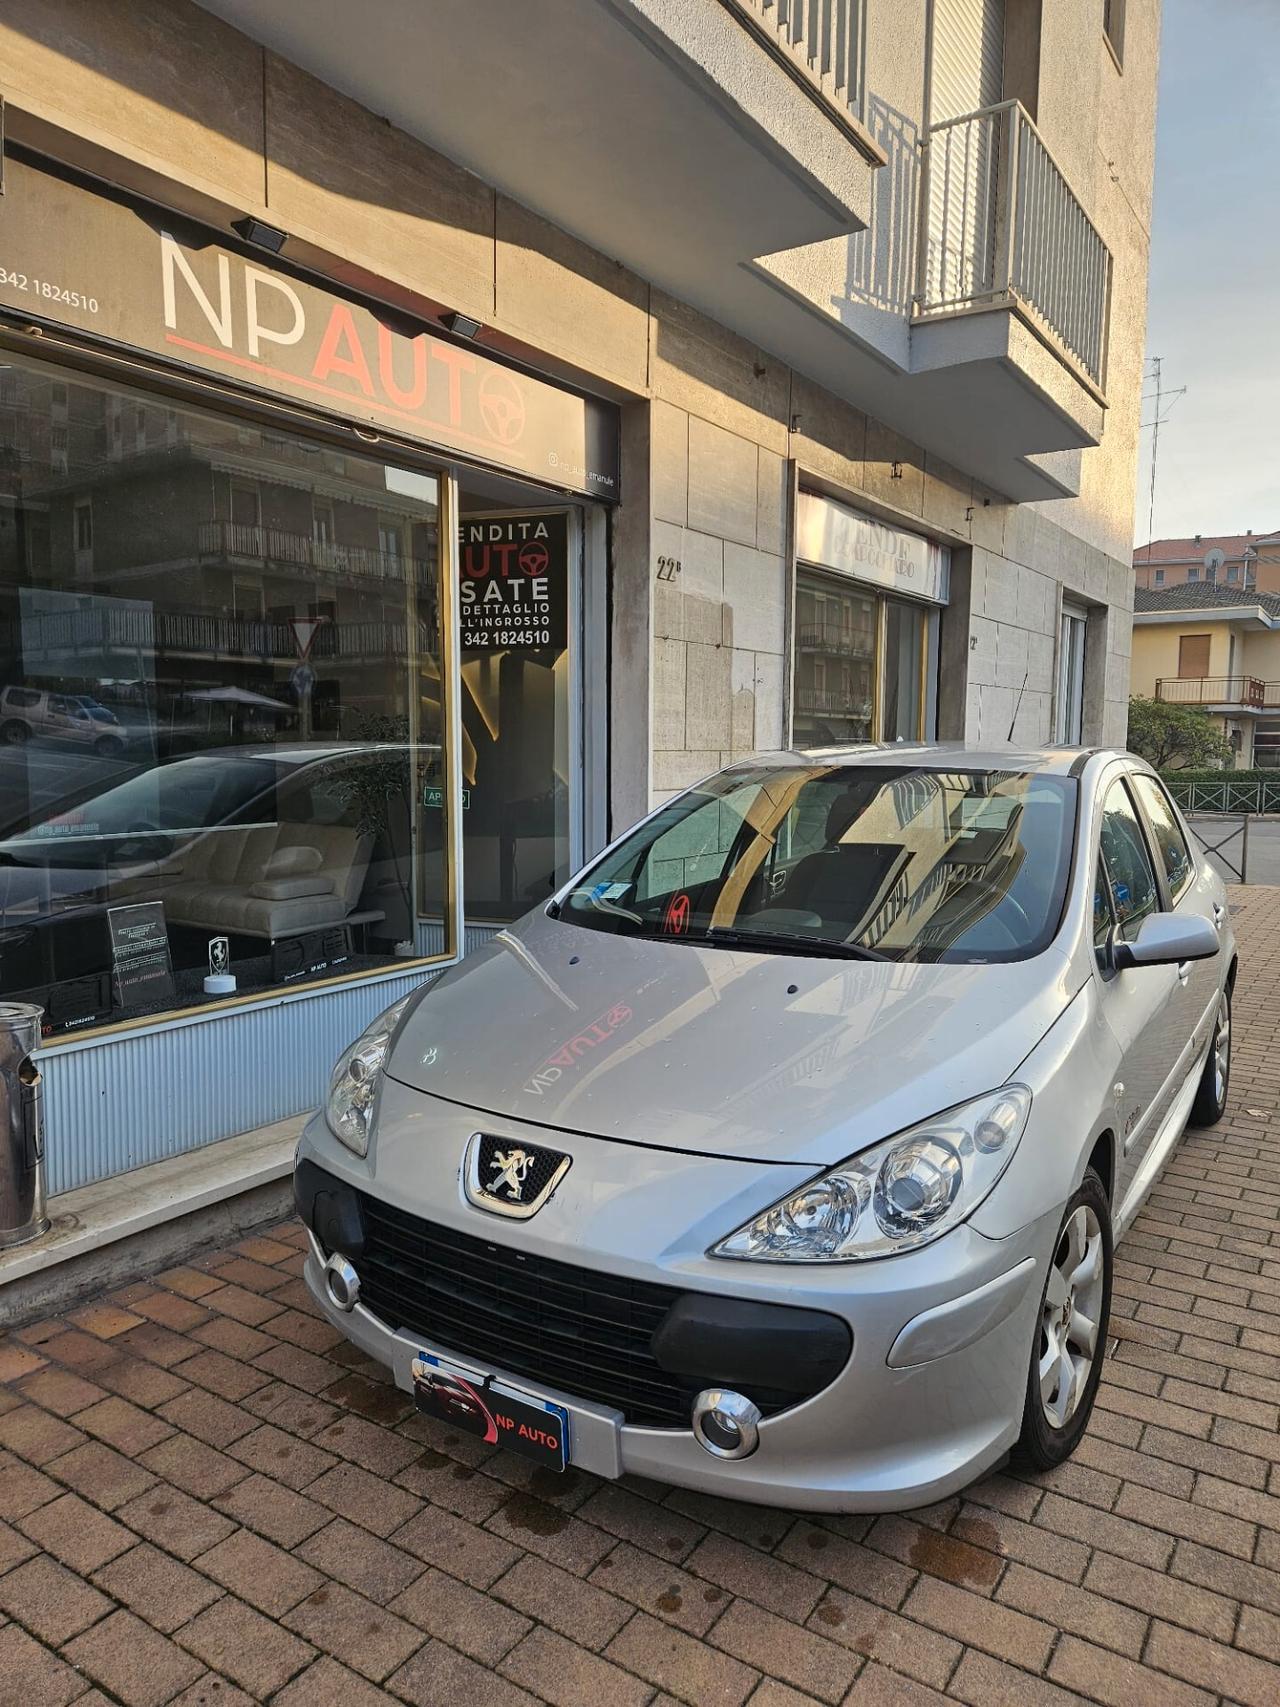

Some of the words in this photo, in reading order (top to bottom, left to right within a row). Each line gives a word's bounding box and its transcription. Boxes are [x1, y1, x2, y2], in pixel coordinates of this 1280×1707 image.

[0, 266, 29, 292] 342
[33, 279, 99, 314] 1824510
[458, 521, 549, 543] ENDITA
[459, 541, 550, 579] UTO
[460, 577, 549, 603] SATE
[462, 602, 550, 616] DETTAGLIO
[459, 615, 550, 628] LL'INGROSSO
[464, 631, 489, 646] 342
[492, 629, 550, 645] 1824510
[495, 1413, 515, 1431] NP
[518, 1423, 558, 1450] AUTO
